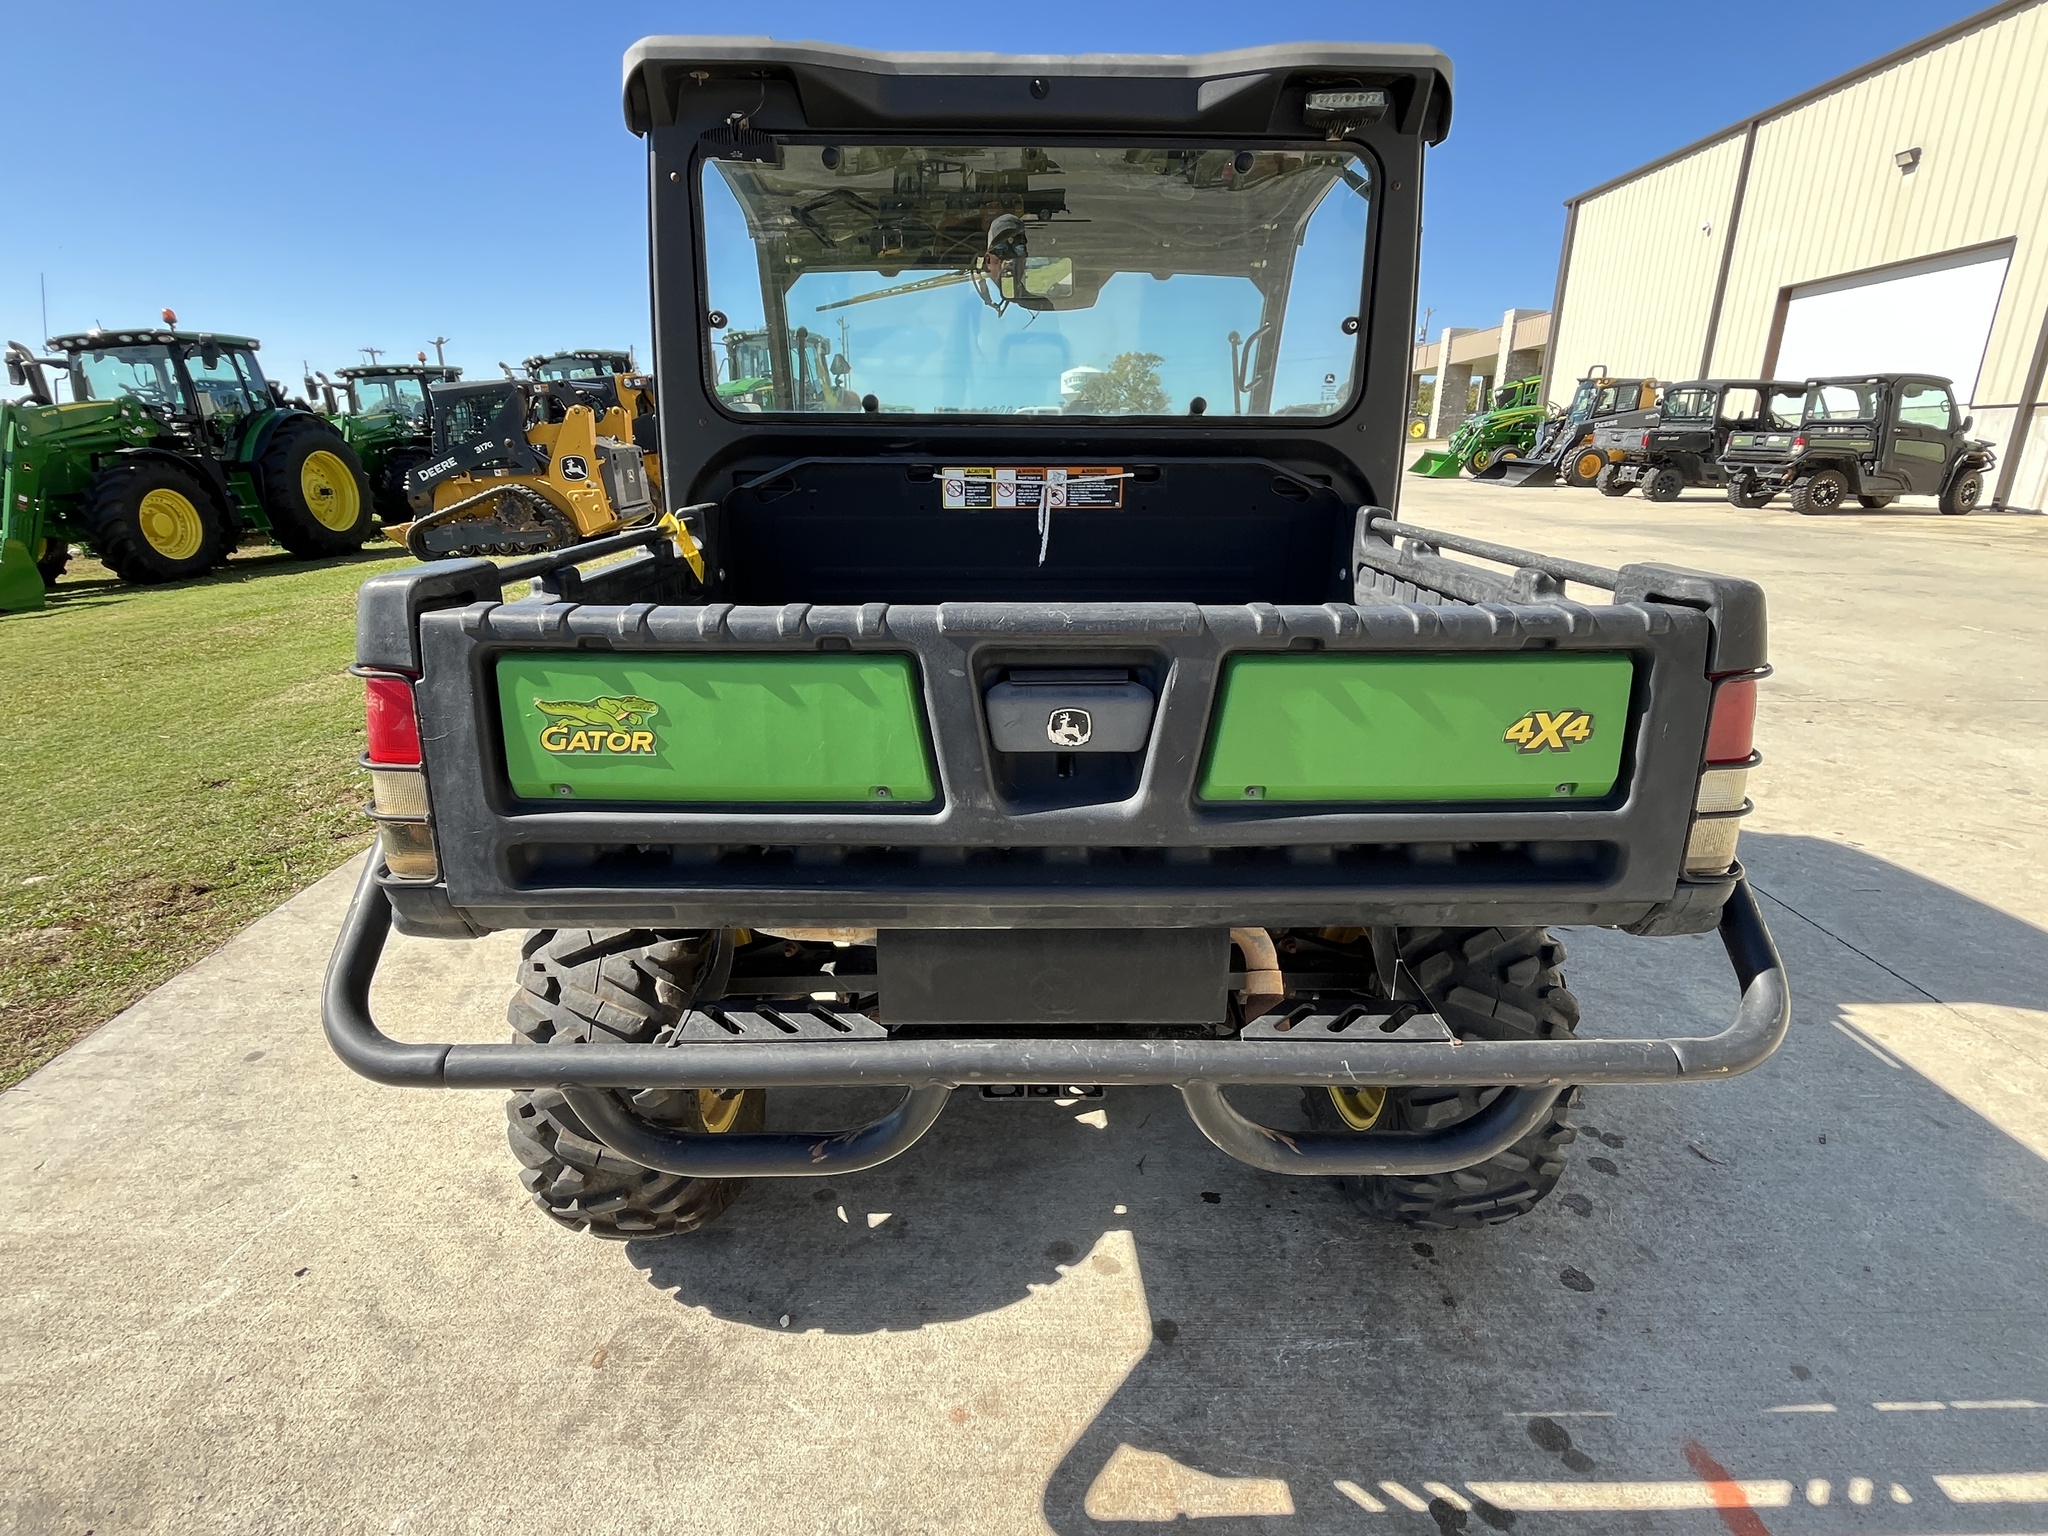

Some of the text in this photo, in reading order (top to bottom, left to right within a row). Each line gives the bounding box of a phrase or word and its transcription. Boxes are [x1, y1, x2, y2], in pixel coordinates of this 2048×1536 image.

[474, 441, 494, 454] 317G
[417, 456, 458, 481] DEERE
[540, 726, 655, 753] GATOR
[1504, 711, 1592, 751] 4X4
